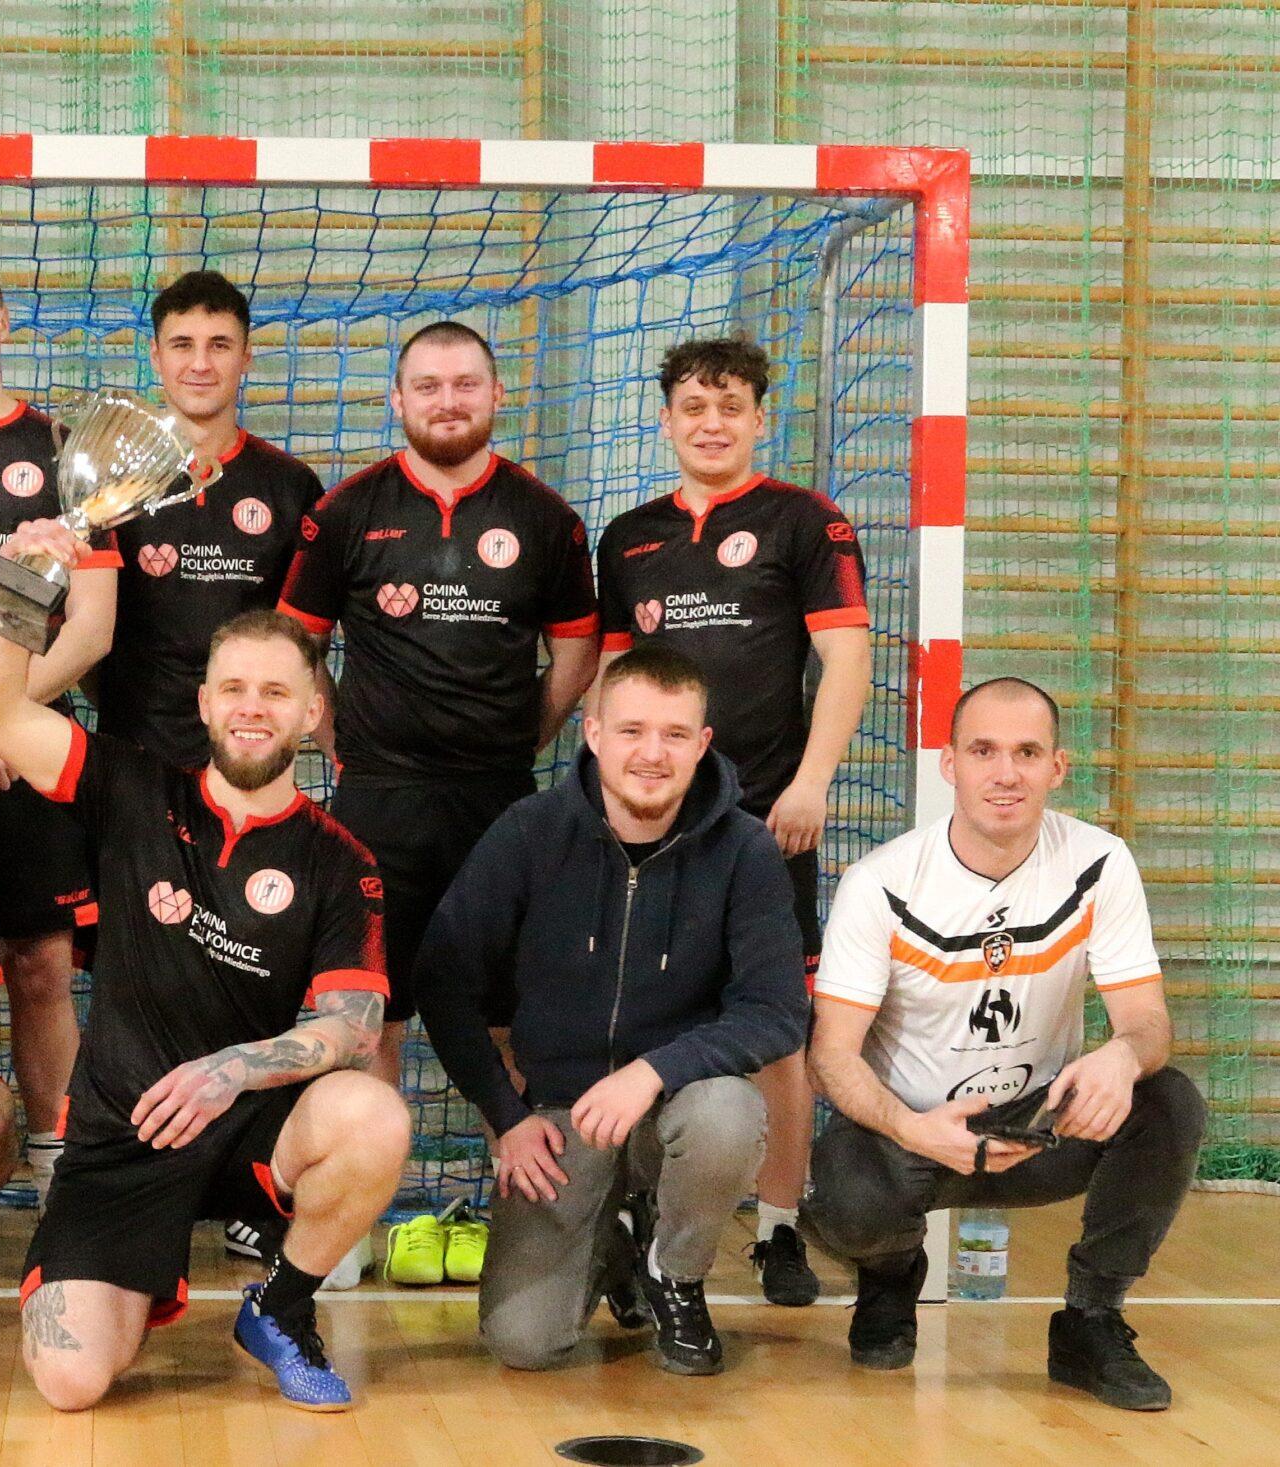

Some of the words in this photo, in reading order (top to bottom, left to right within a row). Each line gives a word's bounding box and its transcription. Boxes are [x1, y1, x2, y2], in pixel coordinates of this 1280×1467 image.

[180, 543, 223, 557] GMINA
[180, 557, 255, 572] POLKOWICE
[422, 583, 469, 597] GMINA
[422, 597, 502, 613] POLKOWICE
[665, 592, 708, 607] GMINA
[422, 611, 441, 621] Serce
[665, 603, 741, 621] POLKOWICE
[965, 1080, 1020, 1095] PUYOL
